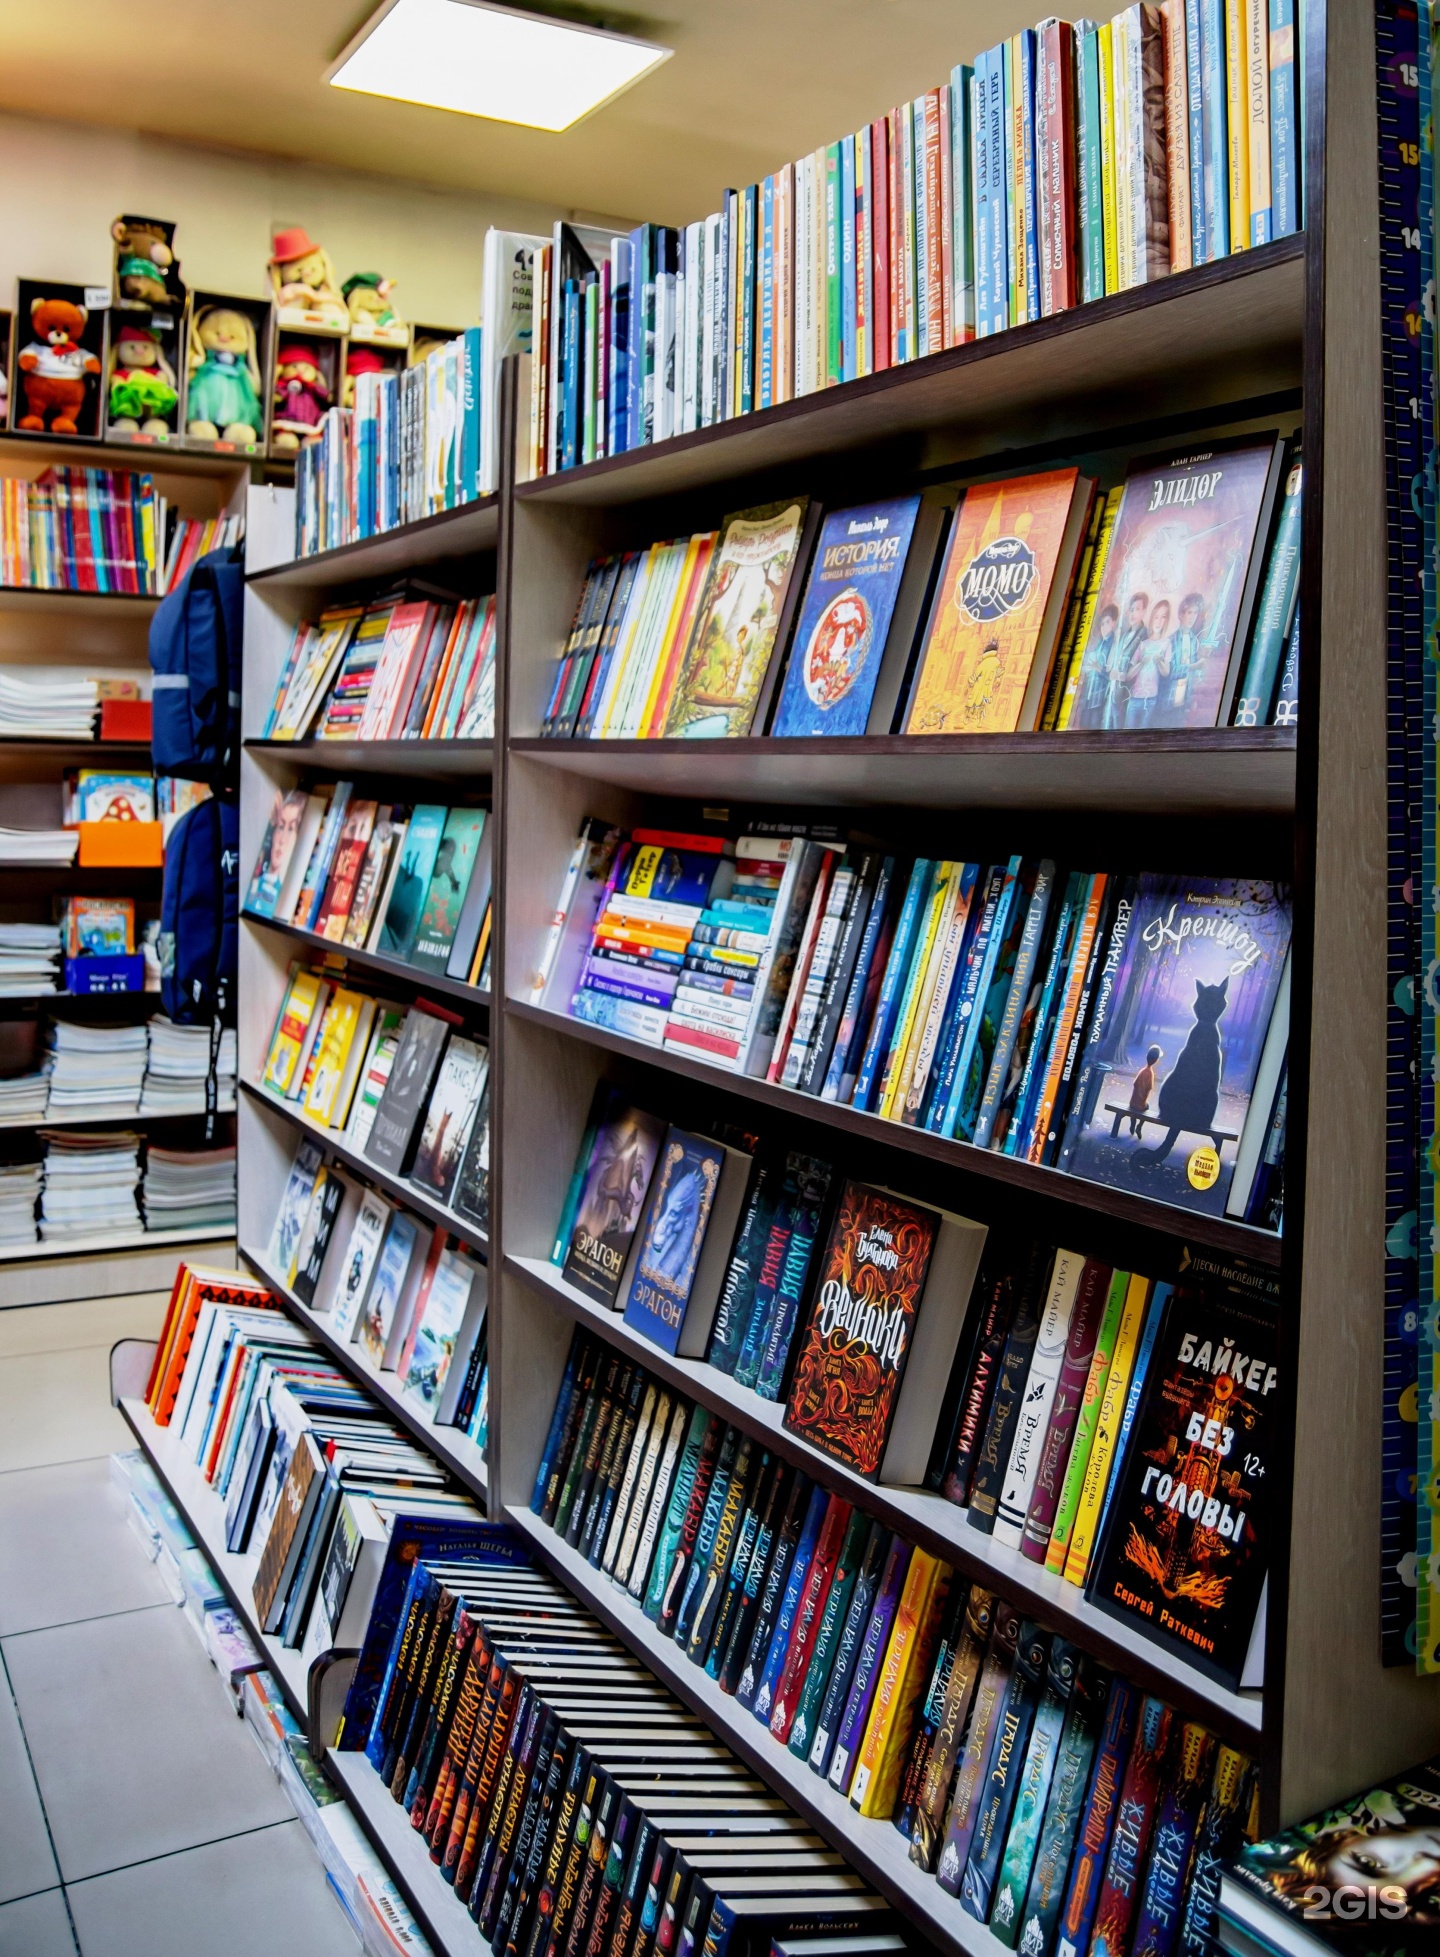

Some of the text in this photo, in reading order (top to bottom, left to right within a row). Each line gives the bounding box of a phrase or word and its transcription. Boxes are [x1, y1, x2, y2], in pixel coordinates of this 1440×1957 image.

[1172, 25, 1182, 99] САРЫ-ТЕПЕ
[1189, 29, 1200, 67] БЕРУТСЯ
[1175, 104, 1182, 119] ИЗ
[1191, 70, 1202, 111] ОТКУДА
[1229, 67, 1238, 104] Тайник
[1250, 59, 1264, 123] ДОЛОЙ
[977, 138, 988, 188] САДАХ
[1175, 123, 1185, 171] ДРУЗЬЯ
[940, 155, 950, 245] Первоклассница
[978, 195, 987, 204] В
[990, 72, 1003, 303] Корней Чуковский СЕРЕБРЯНЫЙ ГЕРБ
[1051, 139, 1063, 270] Солнечный мальчик
[1232, 171, 1240, 200] Тамара
[843, 220, 852, 263] ОДИН
[916, 203, 926, 270] НЕОПЫТНЫХ
[929, 236, 939, 282] Ученик
[979, 217, 989, 286] Рубинштейн
[1025, 165, 1037, 295] Прокофьева ПРИКЛЮЧЕНИЯ
[1179, 231, 1185, 240] С.
[763, 256, 772, 327] ДЕДУШКА
[979, 291, 987, 311] Лев
[763, 336, 771, 399] БАБУЛЯ,
[1170, 453, 1213, 466] АЛАН ГАРНЕР
[1148, 471, 1223, 511] ЭЛИДОР
[879, 562, 895, 572] НЕТ
[964, 562, 1028, 598] МОМО
[980, 903, 997, 932] ИМЕНИ
[1088, 898, 1099, 919] АСЯ
[976, 938, 988, 950] ПО
[1073, 925, 1093, 974] ПЕТРОВА
[1142, 903, 1262, 977] Креншоу
[966, 955, 984, 994] МАЛЬЧИК
[1018, 902, 1070, 1096] Миндальное сердце Черстин Лундберг Хан
[1067, 981, 1081, 1010] ВОЛКИ
[806, 1014, 829, 1065] Кауфман
[826, 980, 838, 1005] ВВЕРХ
[834, 967, 841, 977] ПО
[983, 907, 1042, 1106] ЯЗЫК ЗАКЛИНАНИЙ ГАРРЕТ
[1062, 990, 1091, 1082] ЗАМОК РОБОТОВ
[1089, 975, 1115, 1044] ТУМАННЫЙ
[866, 1053, 874, 1068] ЛАРА
[917, 1022, 935, 1071] звезды
[945, 1068, 955, 1086] Лара
[575, 1231, 623, 1274] ЭРАГОН
[869, 1224, 893, 1243] Елена
[633, 1281, 683, 1329] ЭРАГОН
[1044, 1259, 1069, 1337] КАЙ МАЙЕР
[1073, 1269, 1098, 1348] КАЙ МАЙЕР
[1221, 1266, 1265, 1289] НАСЛЕДИЕ
[745, 1297, 766, 1352] ЗАПАДНЯ
[766, 1302, 788, 1364] ПРОКЛЯТИЕ
[1176, 1332, 1277, 1397] БАЙКЕР
[956, 1350, 992, 1455] АЛХИМИКИ
[1184, 1411, 1236, 1456] БЕЗ
[985, 1401, 1014, 1473] ВРЕМЯ
[1015, 1413, 1043, 1483] ВРЕМЯ
[1040, 1426, 1070, 1499] ВРЕМЯ
[1069, 1430, 1087, 1470] Битва
[1242, 1452, 1267, 1478] 12+
[673, 1441, 701, 1521] МИДНАЙТ
[682, 1457, 712, 1542] МАКАБР
[1087, 1446, 1108, 1508] Королева
[1140, 1465, 1247, 1544] ГОЛОВЫ
[696, 1465, 729, 1553] МАКАБР
[712, 1478, 745, 1568] МАКАБР
[439, 1541, 514, 1558] НАТАЛЬЯ ЩЕРБА
[714, 1591, 733, 1647] ВЛАСТЬ ОГНЯ
[1113, 1581, 1216, 1654] Сергей Раткевич
[821, 1673, 842, 1729] ЦЕНТУРИОН
[841, 1692, 862, 1741] ТЕТРАГОН
[940, 1669, 969, 1746] ПАРДУС
[967, 1685, 997, 1761] ПАРДУС
[991, 1710, 1021, 1789] ПАРДУС
[1022, 1729, 1052, 1807] ПАРДУС
[487, 1750, 513, 1836] ЛУНАСТРЫ
[498, 1765, 527, 1853] ЛУНАСТРЫ
[1083, 1753, 1118, 1854] ПИЛИГРИМЫ
[1119, 1799, 1129, 1820] ЭРА
[546, 1790, 577, 1885] ТРИЛУНЬЕ
[1112, 1796, 1146, 1897] ЖИВЫЕ
[1157, 1825, 1167, 1850] ЭРА
[1150, 1823, 1186, 1928] ЖИВЫЕ
